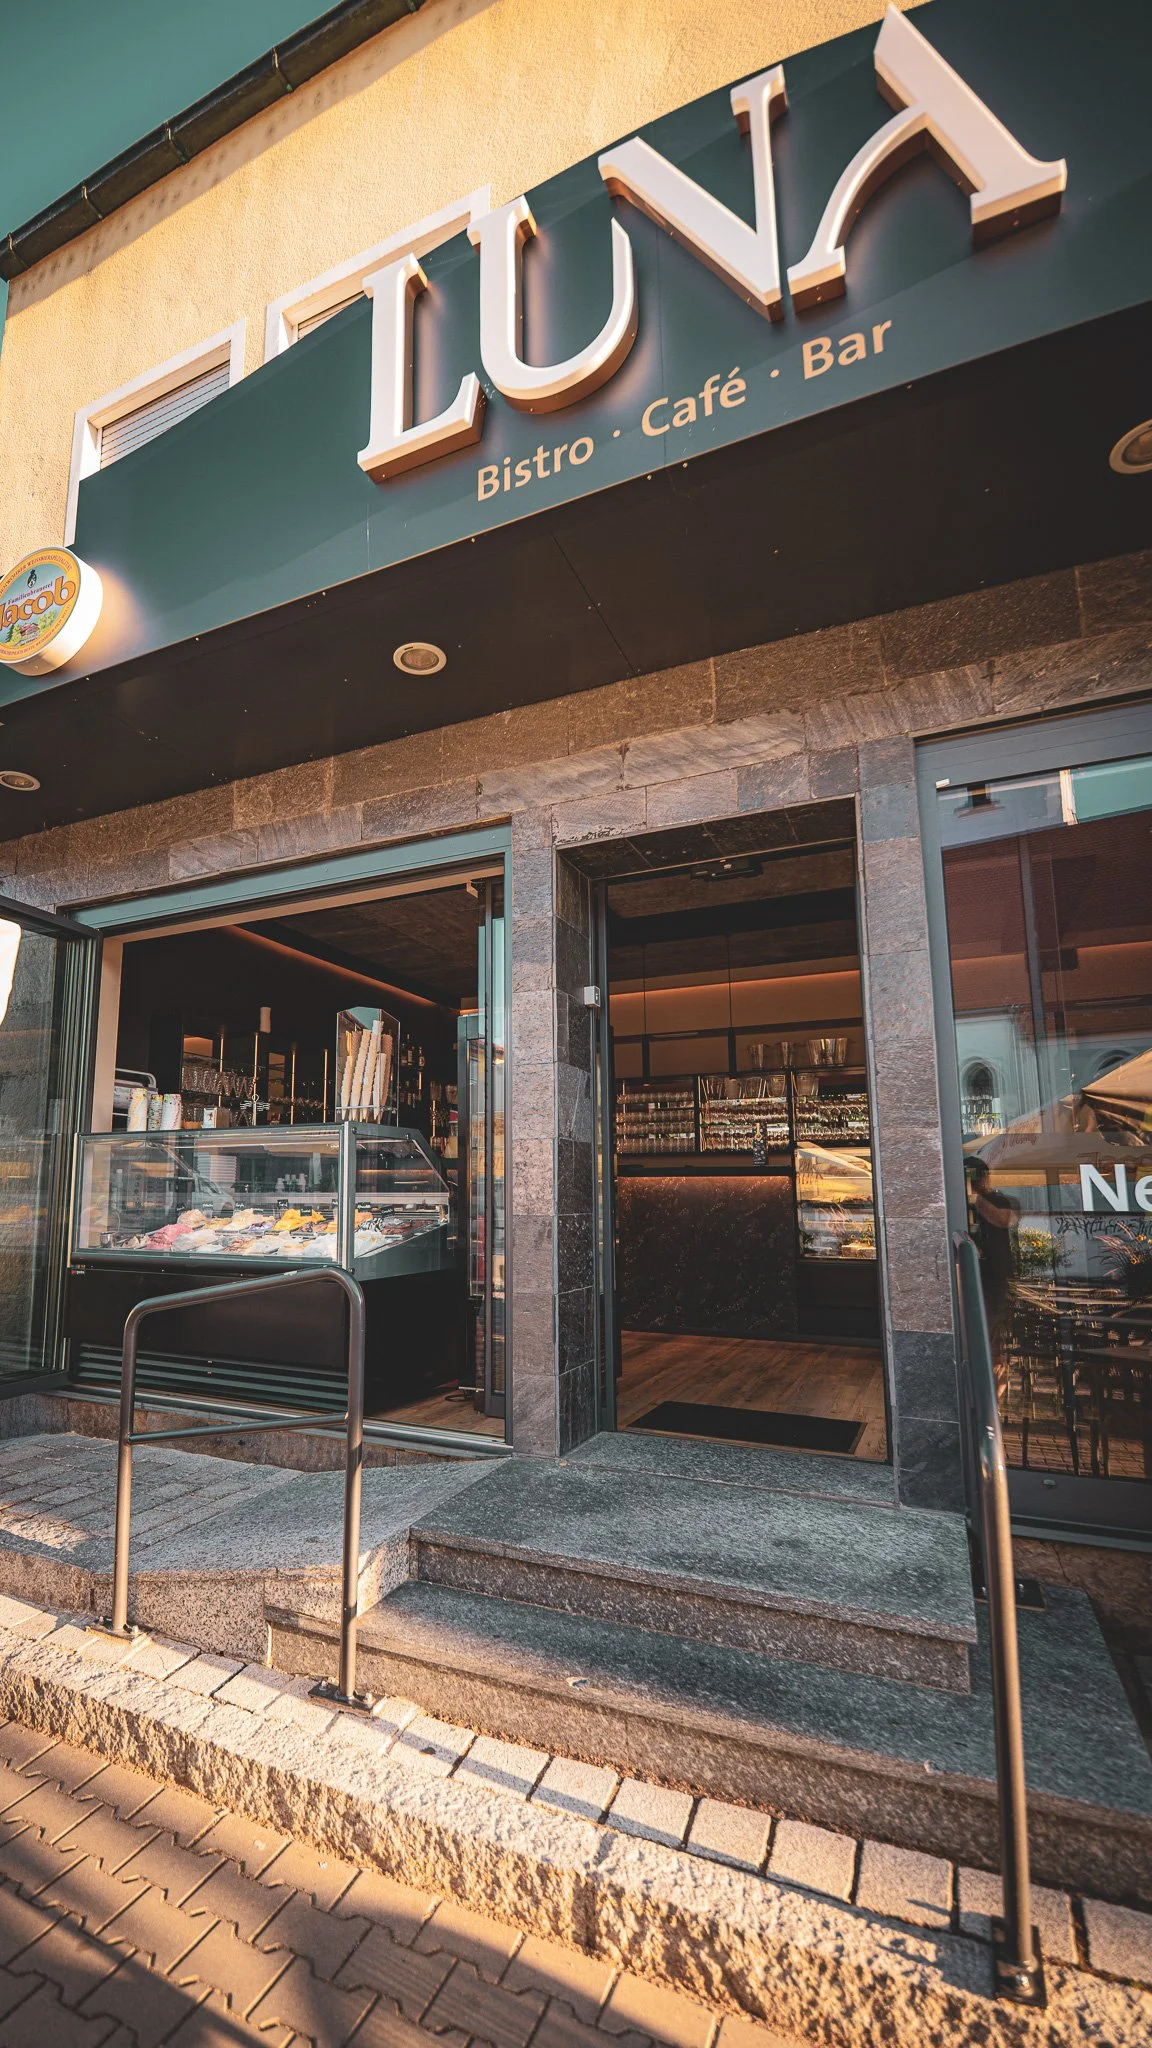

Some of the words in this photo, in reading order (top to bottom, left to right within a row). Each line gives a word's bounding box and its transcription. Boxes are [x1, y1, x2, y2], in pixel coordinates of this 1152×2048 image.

[357, 3, 1068, 481] LUVA
[477, 433, 595, 502] Bistro
[641, 366, 747, 438] Café
[802, 318, 894, 380] Bar
[1080, 1163, 1152, 1212] Ne
